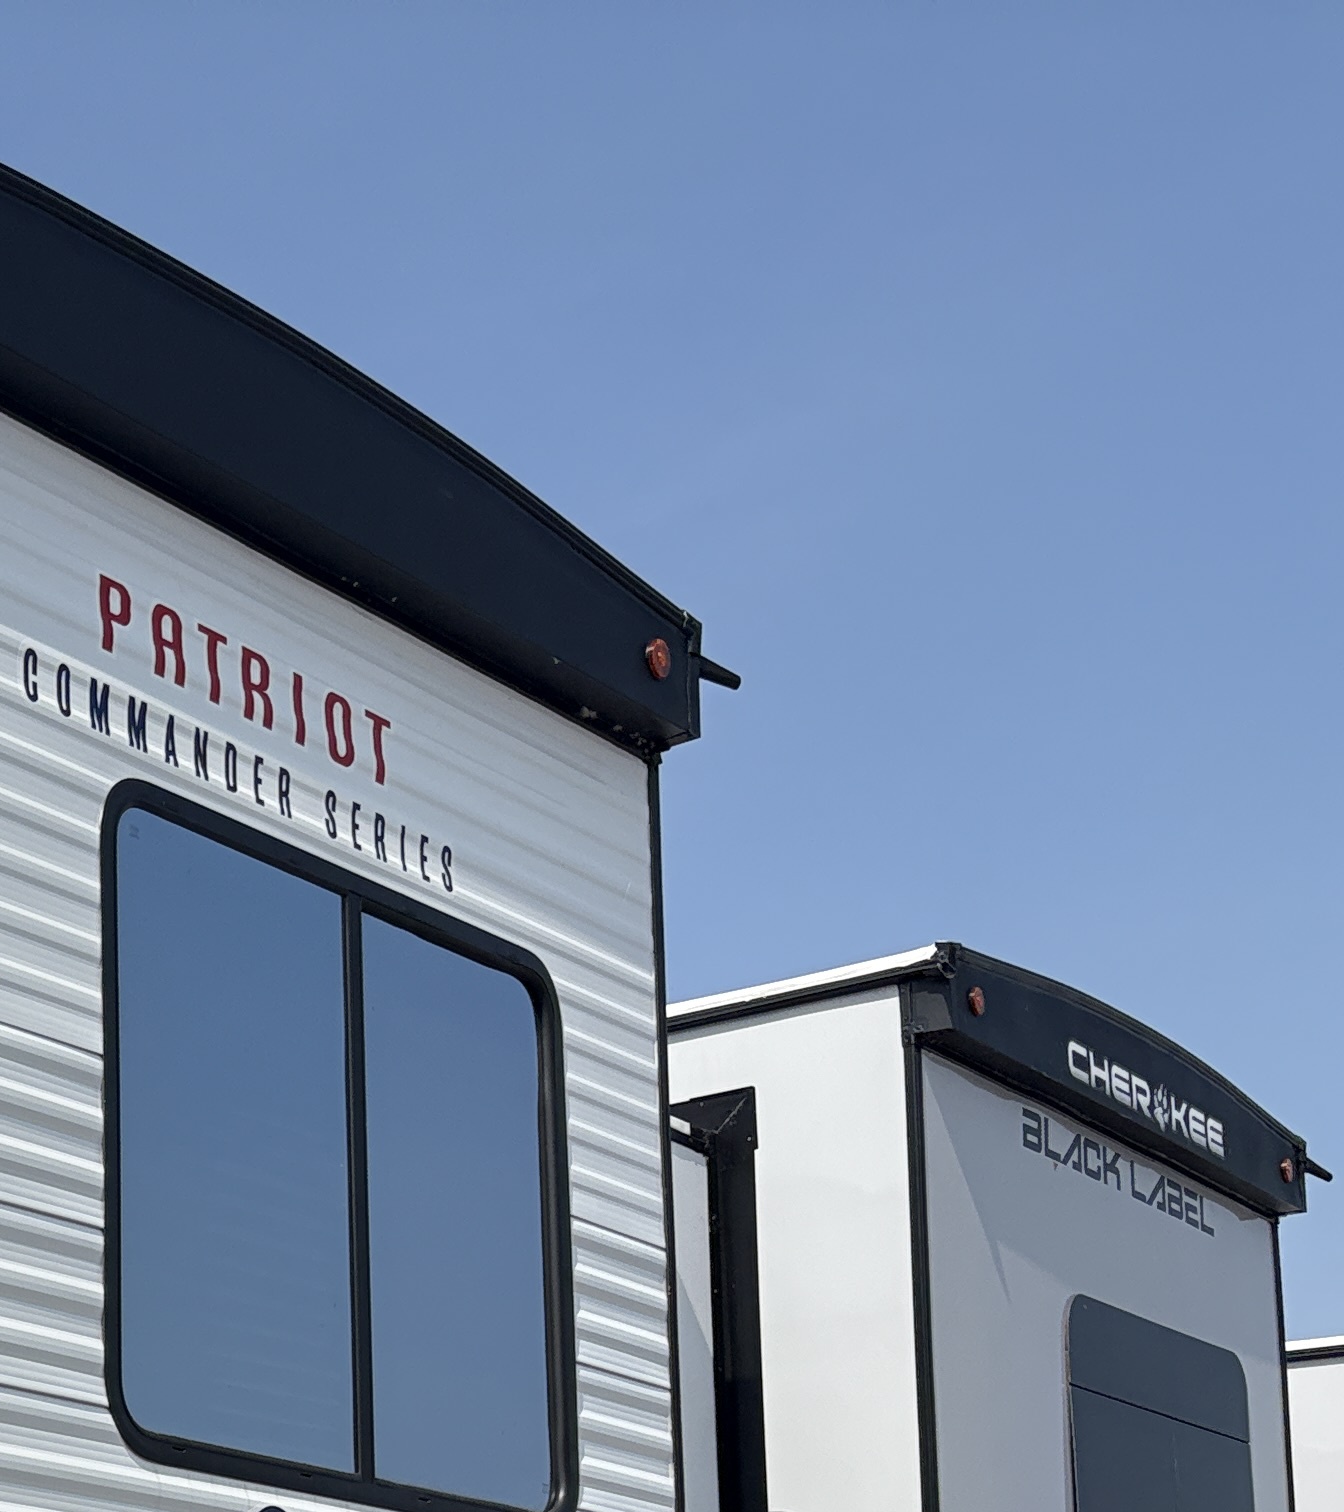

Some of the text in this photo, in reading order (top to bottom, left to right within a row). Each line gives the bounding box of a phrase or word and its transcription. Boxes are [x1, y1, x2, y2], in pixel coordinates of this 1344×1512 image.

[23, 648, 453, 893] COMMANDER SERIES
[99, 573, 391, 785] PATRIOT
[1022, 1106, 1215, 1237] BLACK LABEL
